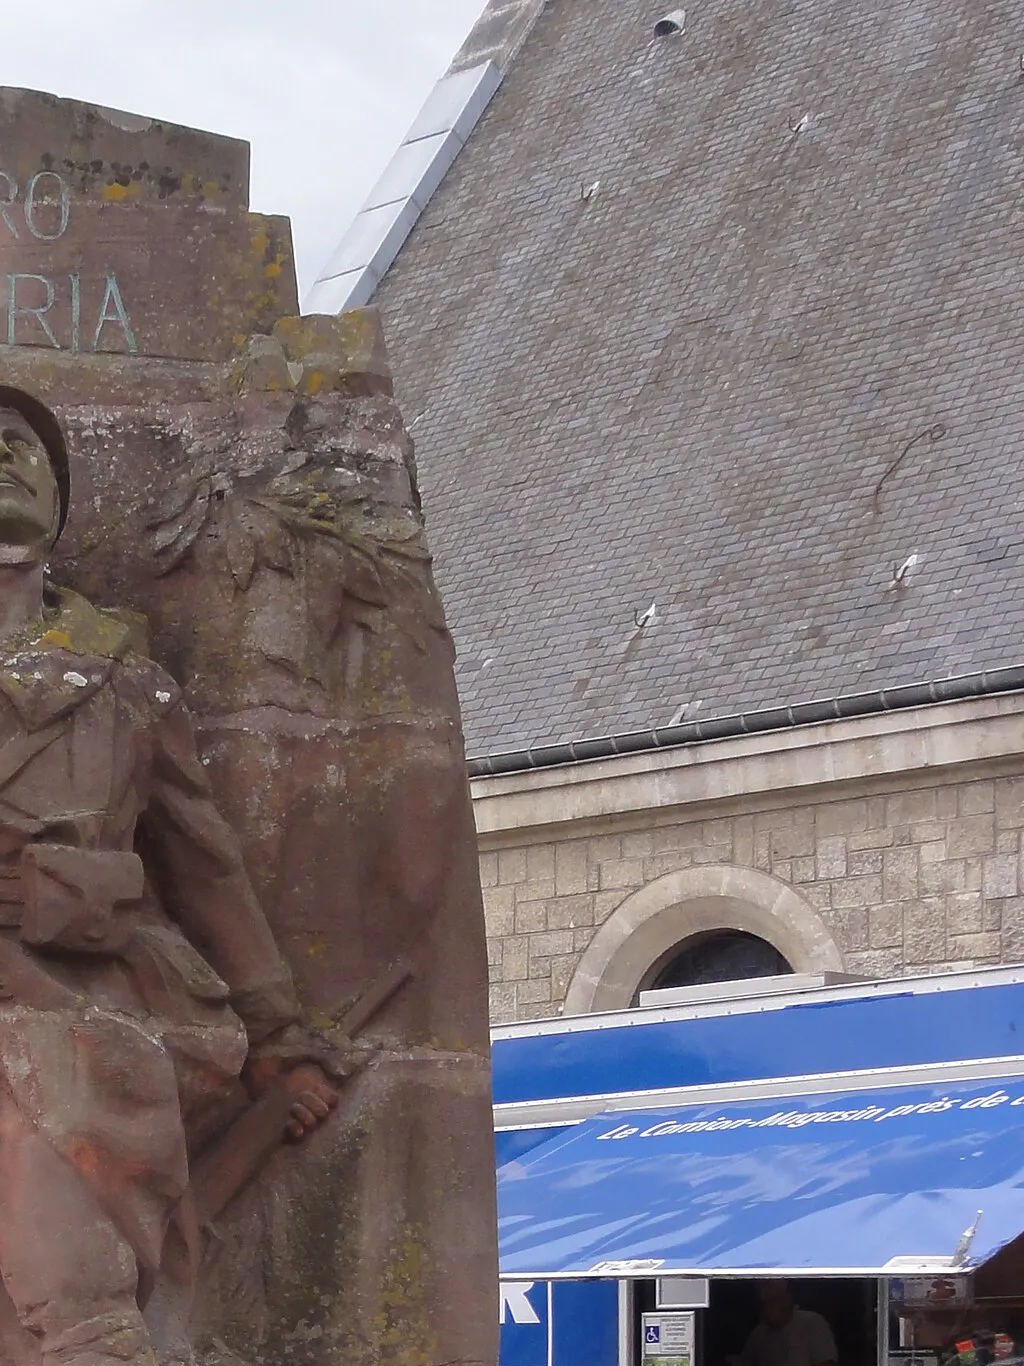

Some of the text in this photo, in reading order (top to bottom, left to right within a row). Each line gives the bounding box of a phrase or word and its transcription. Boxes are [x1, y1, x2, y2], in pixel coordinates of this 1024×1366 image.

[596, 1124, 639, 1140] Le
[640, 1105, 886, 1138] Camion-Magasin
[960, 1090, 1010, 1110] de
